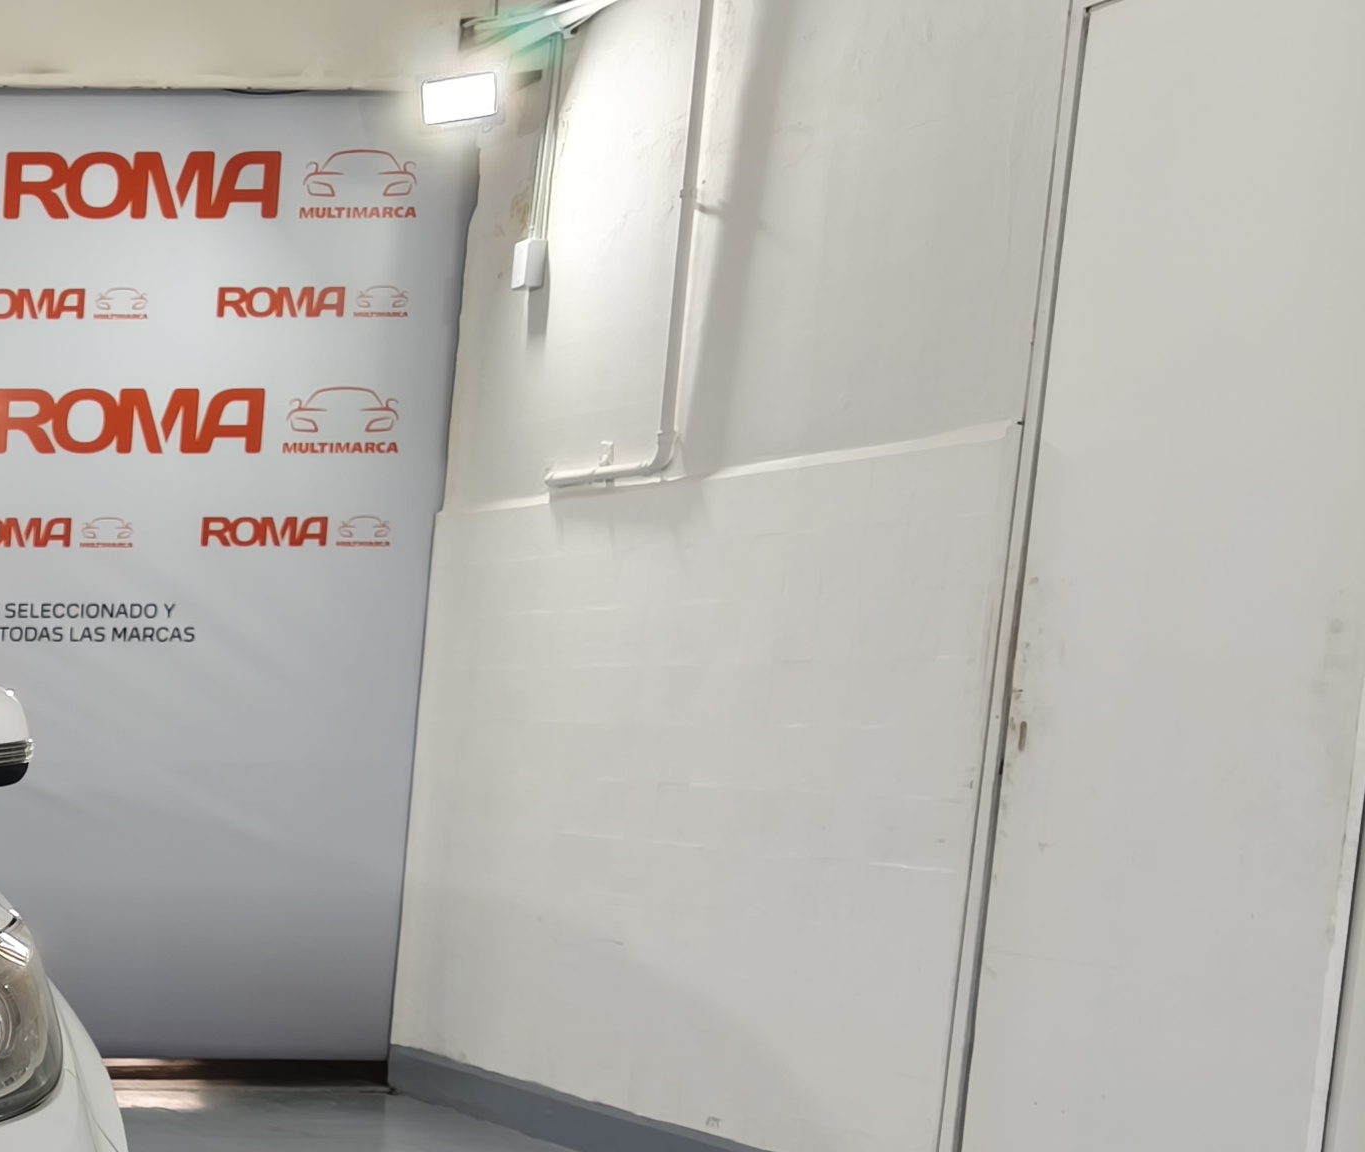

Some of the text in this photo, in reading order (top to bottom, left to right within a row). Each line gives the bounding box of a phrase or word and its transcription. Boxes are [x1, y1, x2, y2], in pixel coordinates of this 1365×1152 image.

[2, 151, 282, 219] ROMA
[299, 206, 417, 219] MULTIMARCA
[217, 287, 346, 318] ROMA
[283, 442, 399, 453] MULTIMARCA
[201, 516, 329, 547] ROMA
[5, 603, 158, 619] SELECCIONADO
[164, 604, 175, 618] Y
[70, 627, 105, 642] LAS
[112, 627, 195, 642] MARCAS
